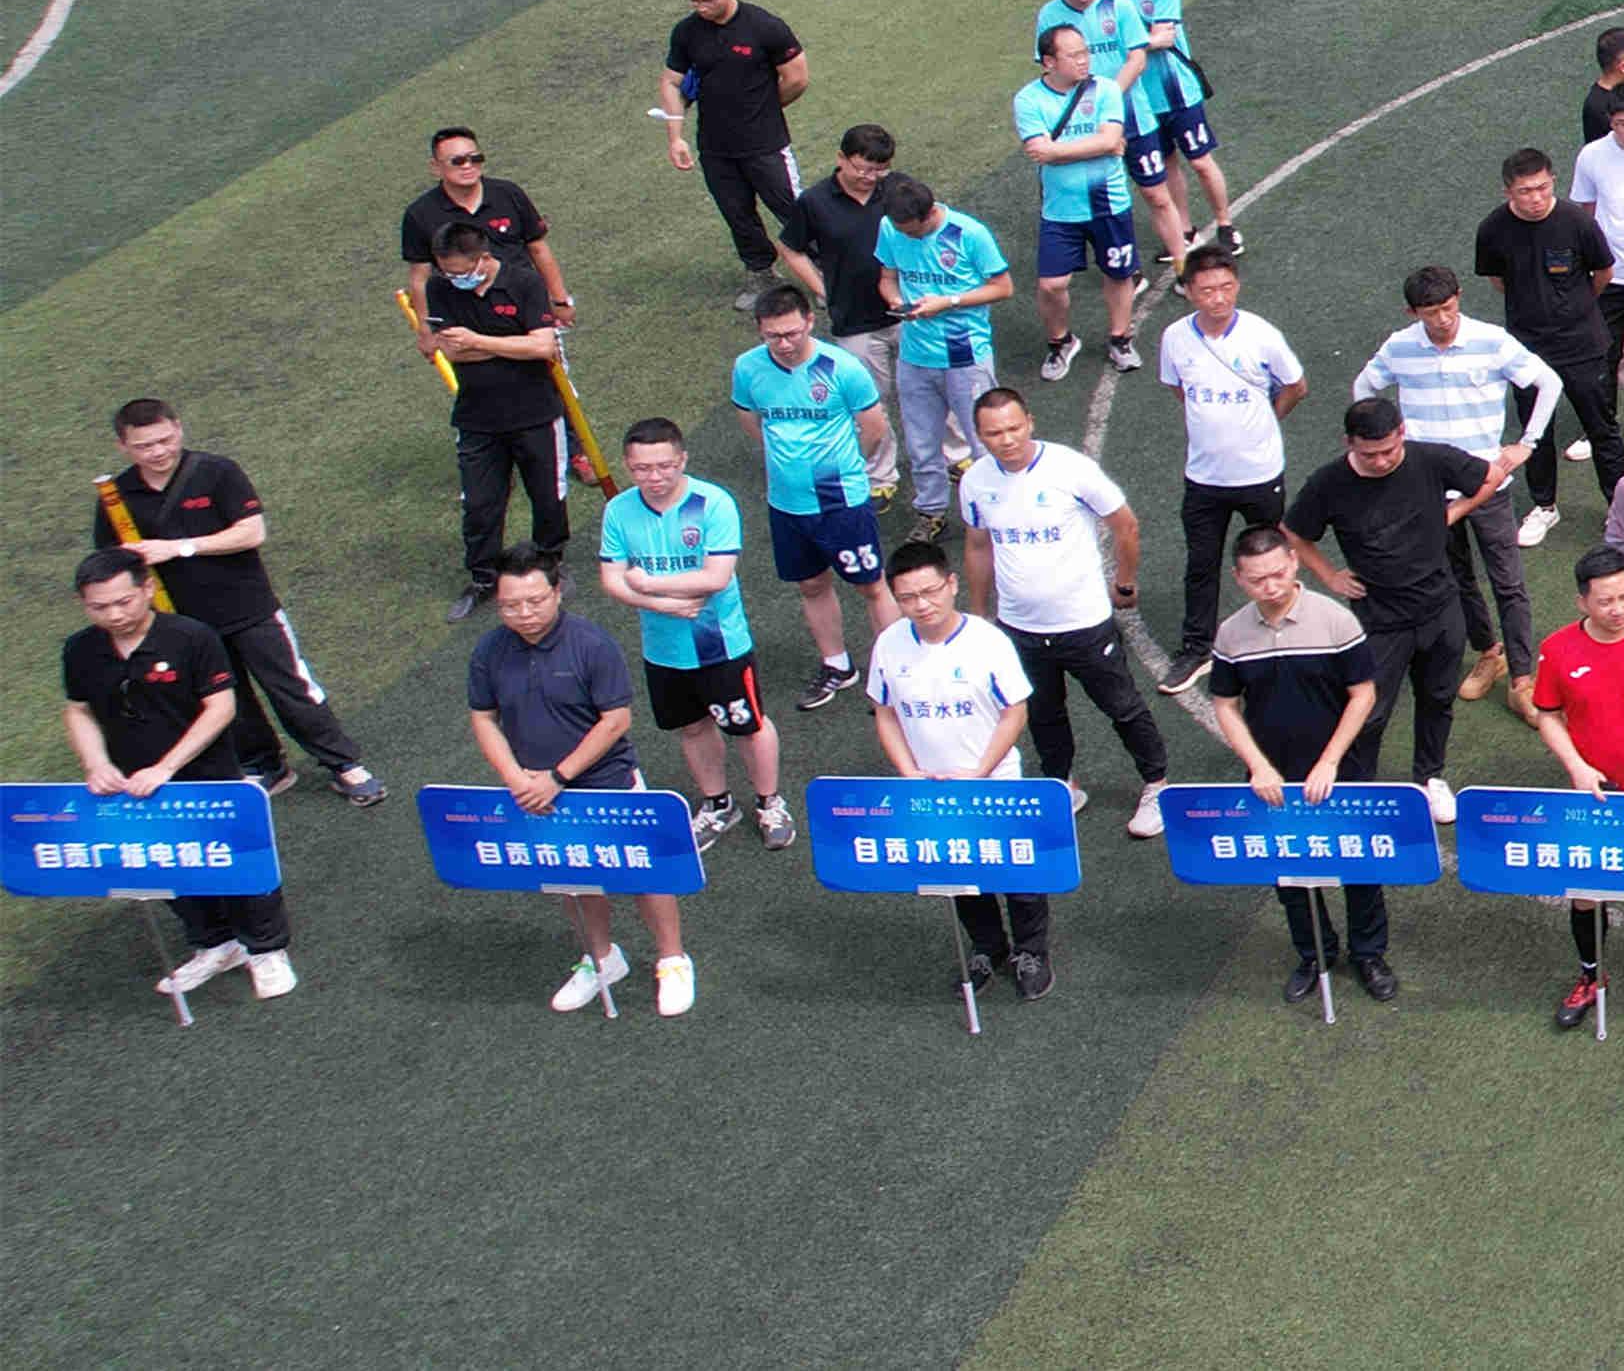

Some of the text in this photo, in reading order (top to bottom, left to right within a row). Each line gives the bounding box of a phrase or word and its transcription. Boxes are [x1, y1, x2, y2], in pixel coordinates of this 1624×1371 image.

[1184, 123, 1208, 151] 14
[1107, 243, 1133, 268] 27
[991, 525, 1062, 545] 自贡水投
[900, 700, 975, 719] 自贡水投
[34, 841, 233, 868] 自贡广播电视台
[475, 841, 652, 868] 自贡市规划院
[854, 837, 1035, 865] 自贡水投集团
[1211, 834, 1397, 859] 自贡汇东股份
